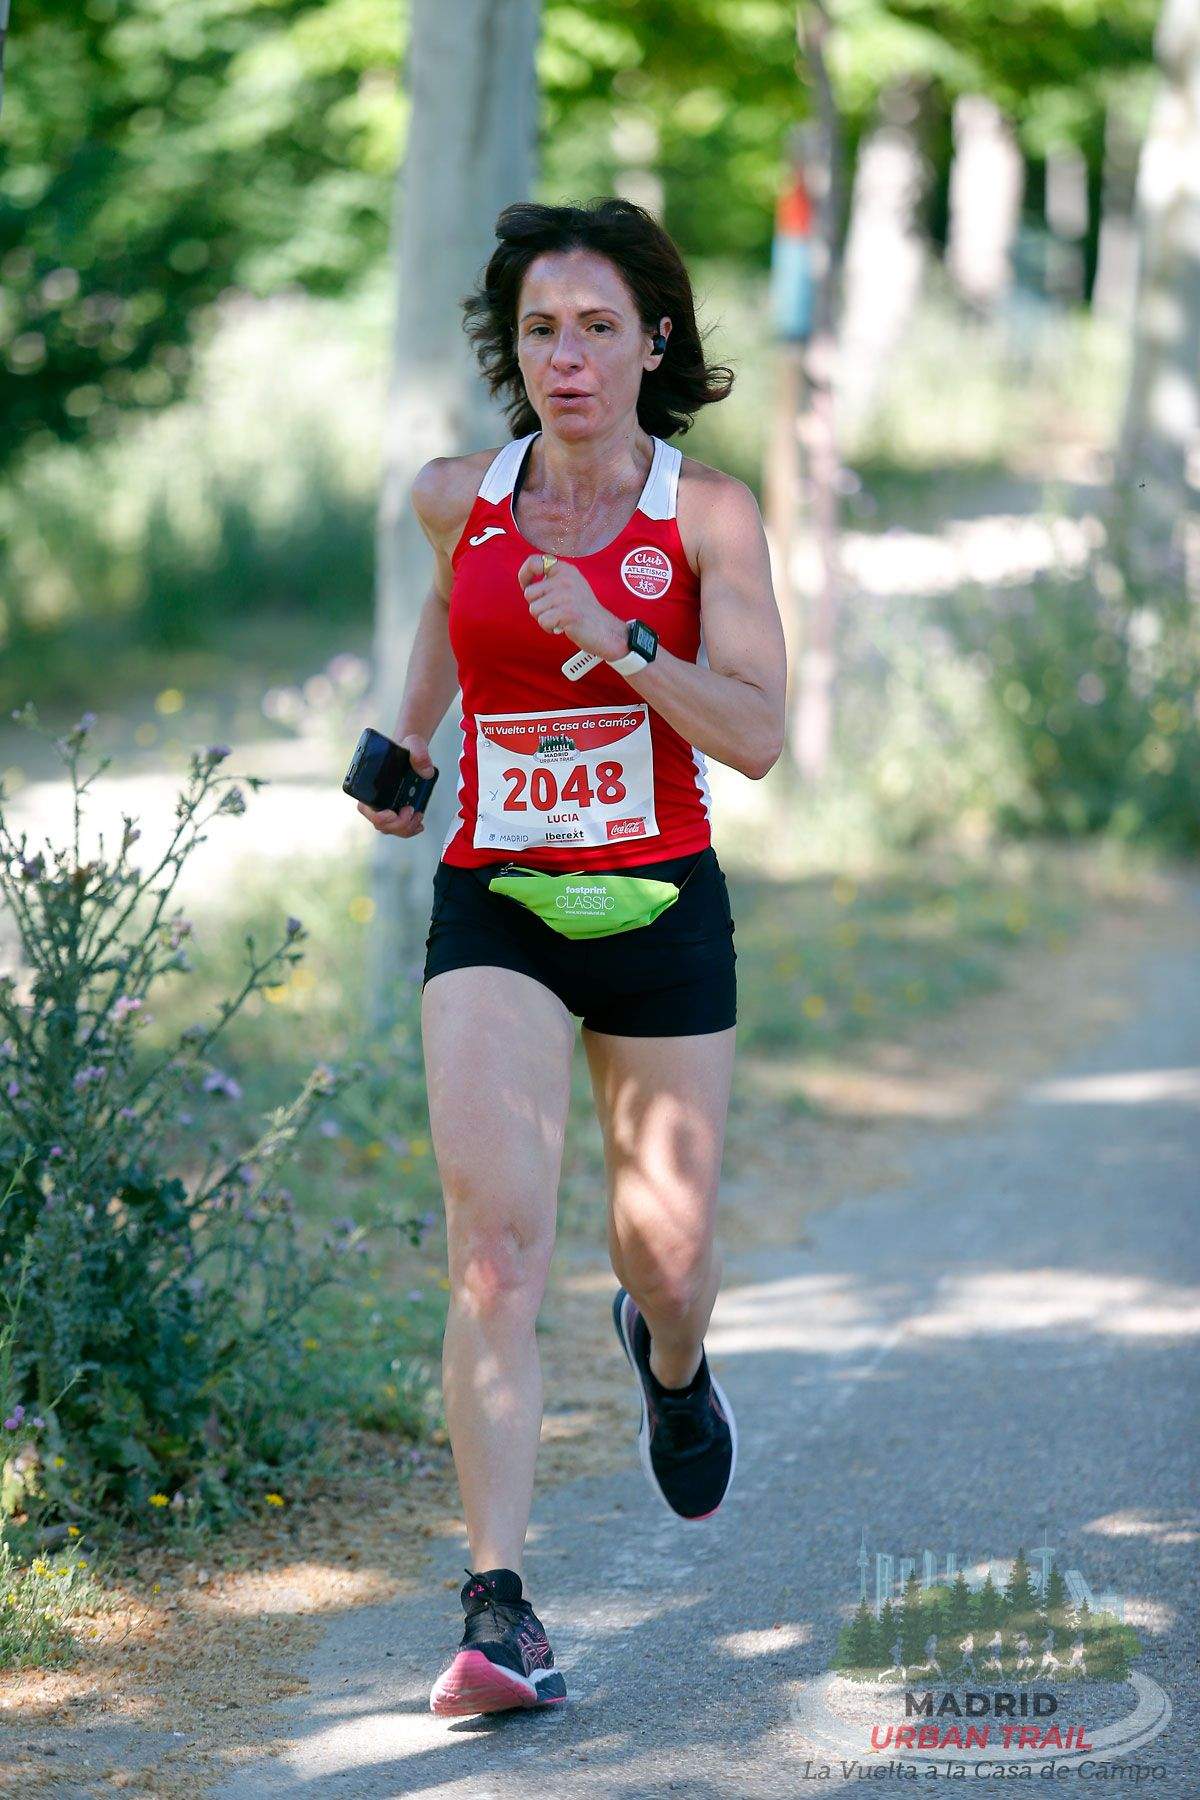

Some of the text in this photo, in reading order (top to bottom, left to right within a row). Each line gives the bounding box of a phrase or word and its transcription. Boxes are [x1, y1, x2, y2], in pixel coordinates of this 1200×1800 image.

[634, 553, 664, 565] Club
[627, 566, 667, 578] ATLETISMO
[484, 726, 494, 735] XII
[496, 725, 525, 735] Vuelta
[537, 724, 547, 733] la
[552, 722, 579, 731] Casa
[581, 721, 595, 730] de
[598, 717, 637, 729] Campo
[502, 761, 627, 812] 2048
[547, 813, 579, 824] LUCIA
[500, 834, 529, 842] MADRID
[546, 831, 585, 840] Iberext
[556, 895, 614, 909] CLASSIC
